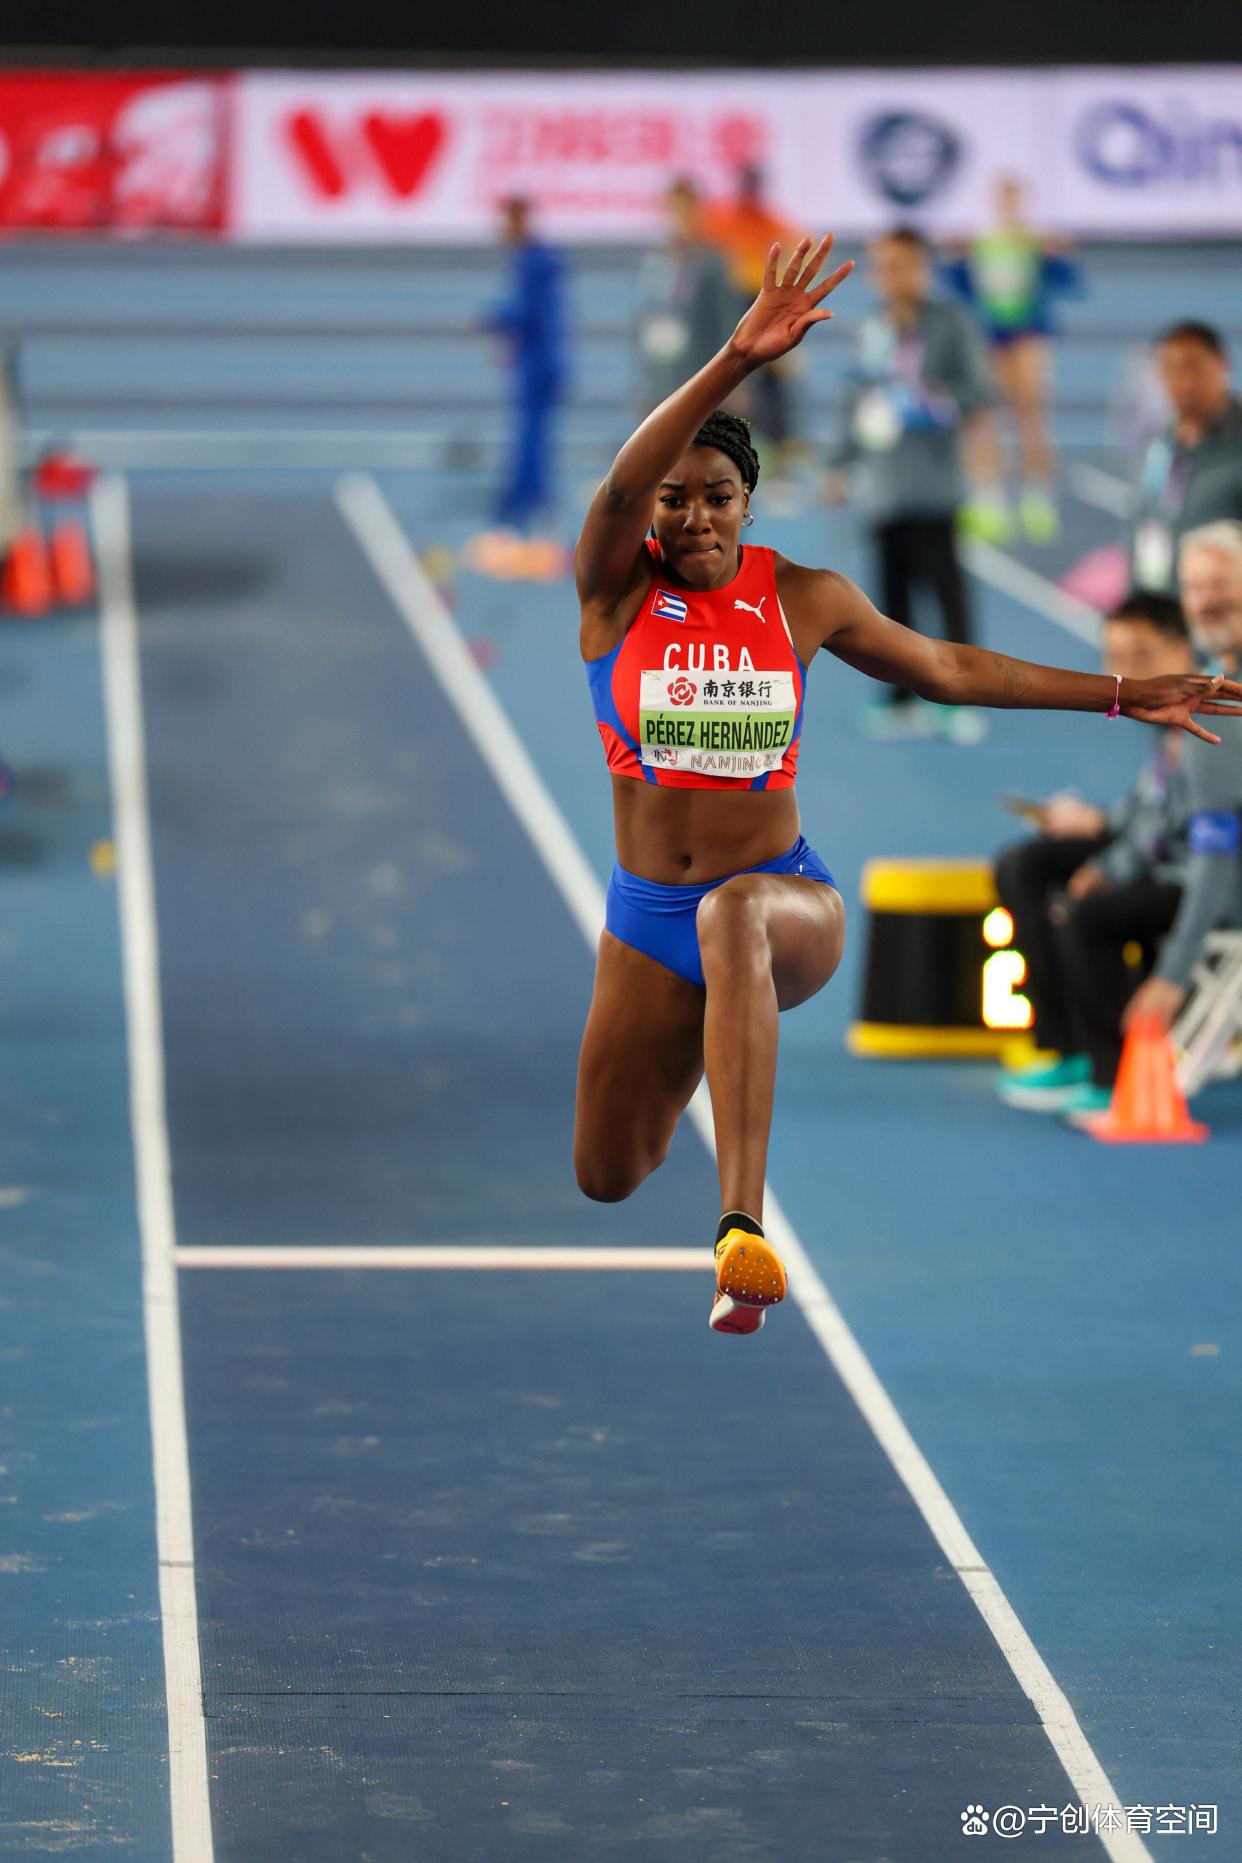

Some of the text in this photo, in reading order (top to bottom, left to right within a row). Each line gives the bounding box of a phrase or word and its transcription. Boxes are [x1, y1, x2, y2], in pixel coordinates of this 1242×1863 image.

[663, 643, 756, 672] CUBA
[703, 679, 772, 698] 南京银行
[646, 713, 790, 750] PÉREZ HERNÁNDEZ
